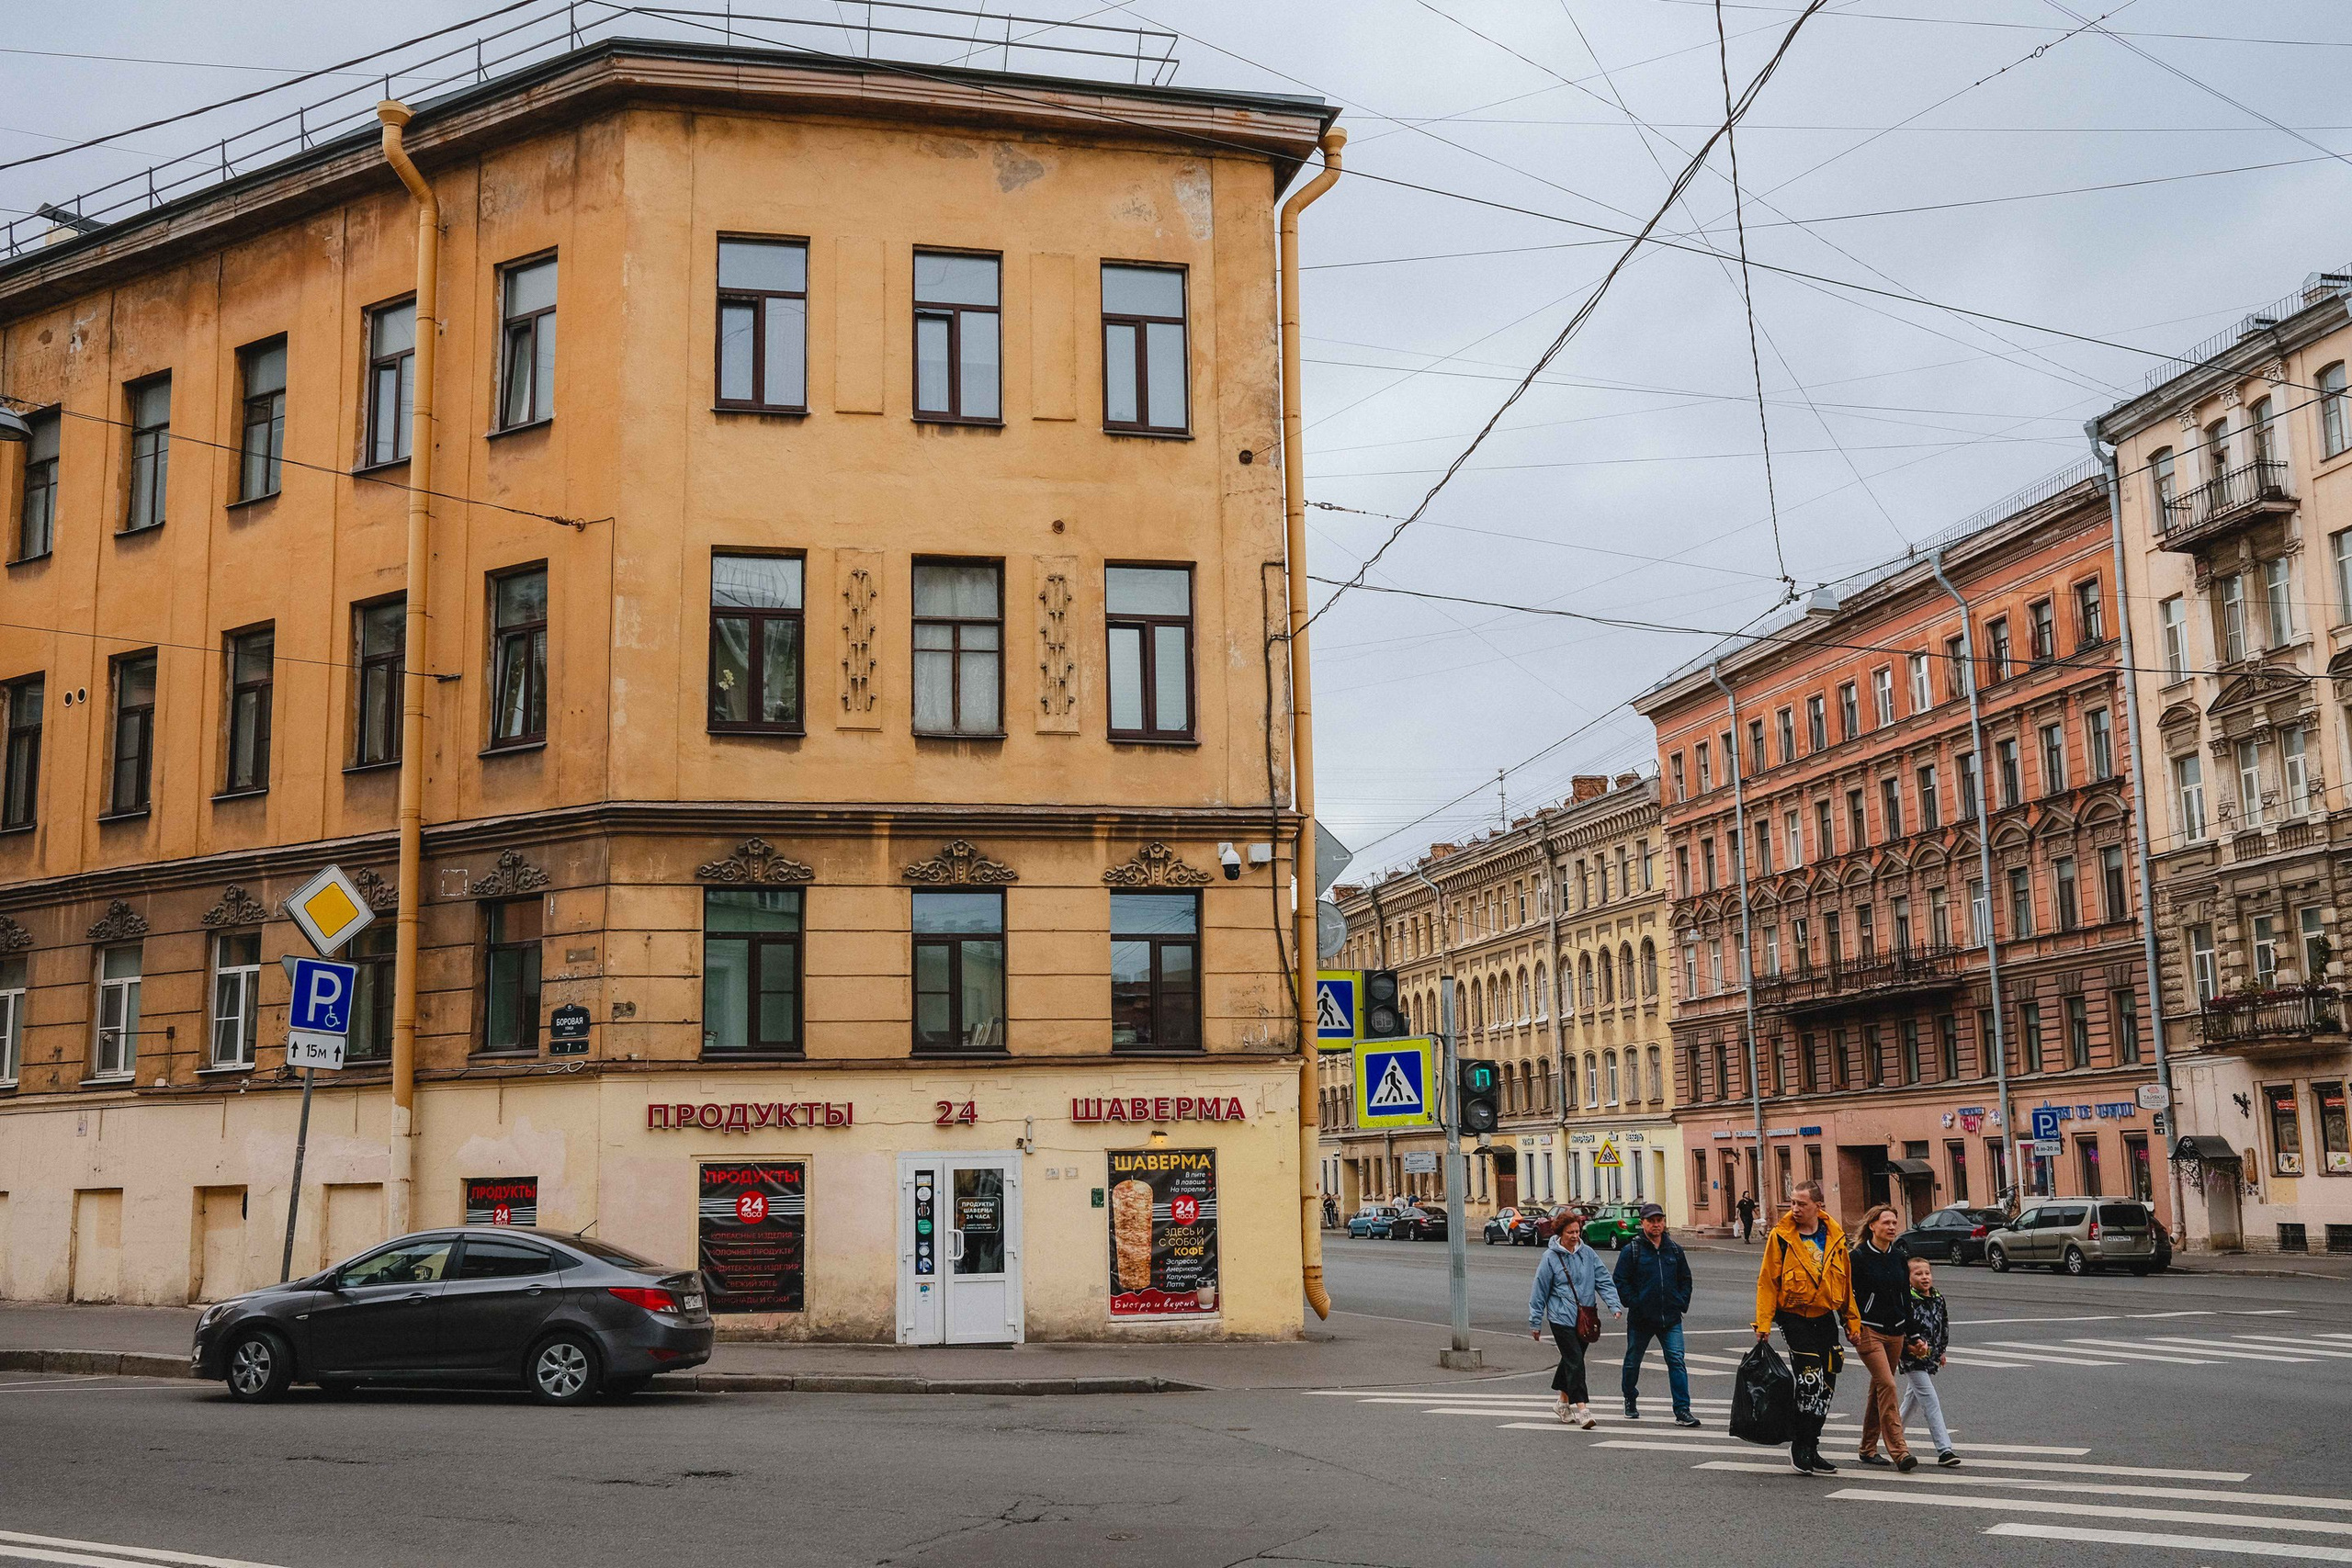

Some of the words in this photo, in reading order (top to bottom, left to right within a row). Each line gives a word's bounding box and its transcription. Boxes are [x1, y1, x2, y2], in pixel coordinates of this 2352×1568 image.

[307, 969, 343, 1021] P
[556, 1016, 583, 1026] БОРОВАЯ
[567, 1043, 571, 1052] 7
[1476, 1069, 1490, 1087] 17
[934, 1100, 969, 1126] 24
[1070, 1097, 1246, 1122] ШАВЕРМА
[646, 1101, 854, 1134] ПРОДУКТЫ
[2039, 1115, 2053, 1137] P
[1114, 1154, 1212, 1171] ШАВЕРМА
[705, 1169, 800, 1186] ПРОДУКТЫ
[471, 1183, 537, 1201] ПРОДУКТЫ
[1181, 1186, 1206, 1194] тарелке
[741, 1197, 764, 1212] 24
[1175, 1201, 1195, 1214] 24
[495, 1209, 509, 1222] 24
[710, 1232, 755, 1241] КОЛБАСНЫЕ
[758, 1231, 794, 1240] ИЗДЕЛИЯ
[1164, 1227, 1195, 1237] ЗДЕСЬ
[1196, 1227, 1204, 1235] И
[1159, 1238, 1167, 1247] С
[1168, 1236, 1204, 1247] СОБОЙ
[707, 1247, 752, 1257] МОЛОЧНЫЕ
[753, 1247, 795, 1256] ПРОДУКТЫ
[1174, 1247, 1204, 1257] КОФЕ
[705, 1264, 762, 1273] КОНДИТЕРСКИЕ
[764, 1262, 799, 1271] ИЗДЕЛИЯ
[1165, 1258, 1198, 1267] Эспрессо
[767, 1295, 790, 1303] СОКИ
[1114, 1300, 1151, 1312] Быстро
[1163, 1297, 1195, 1310] вкусно
